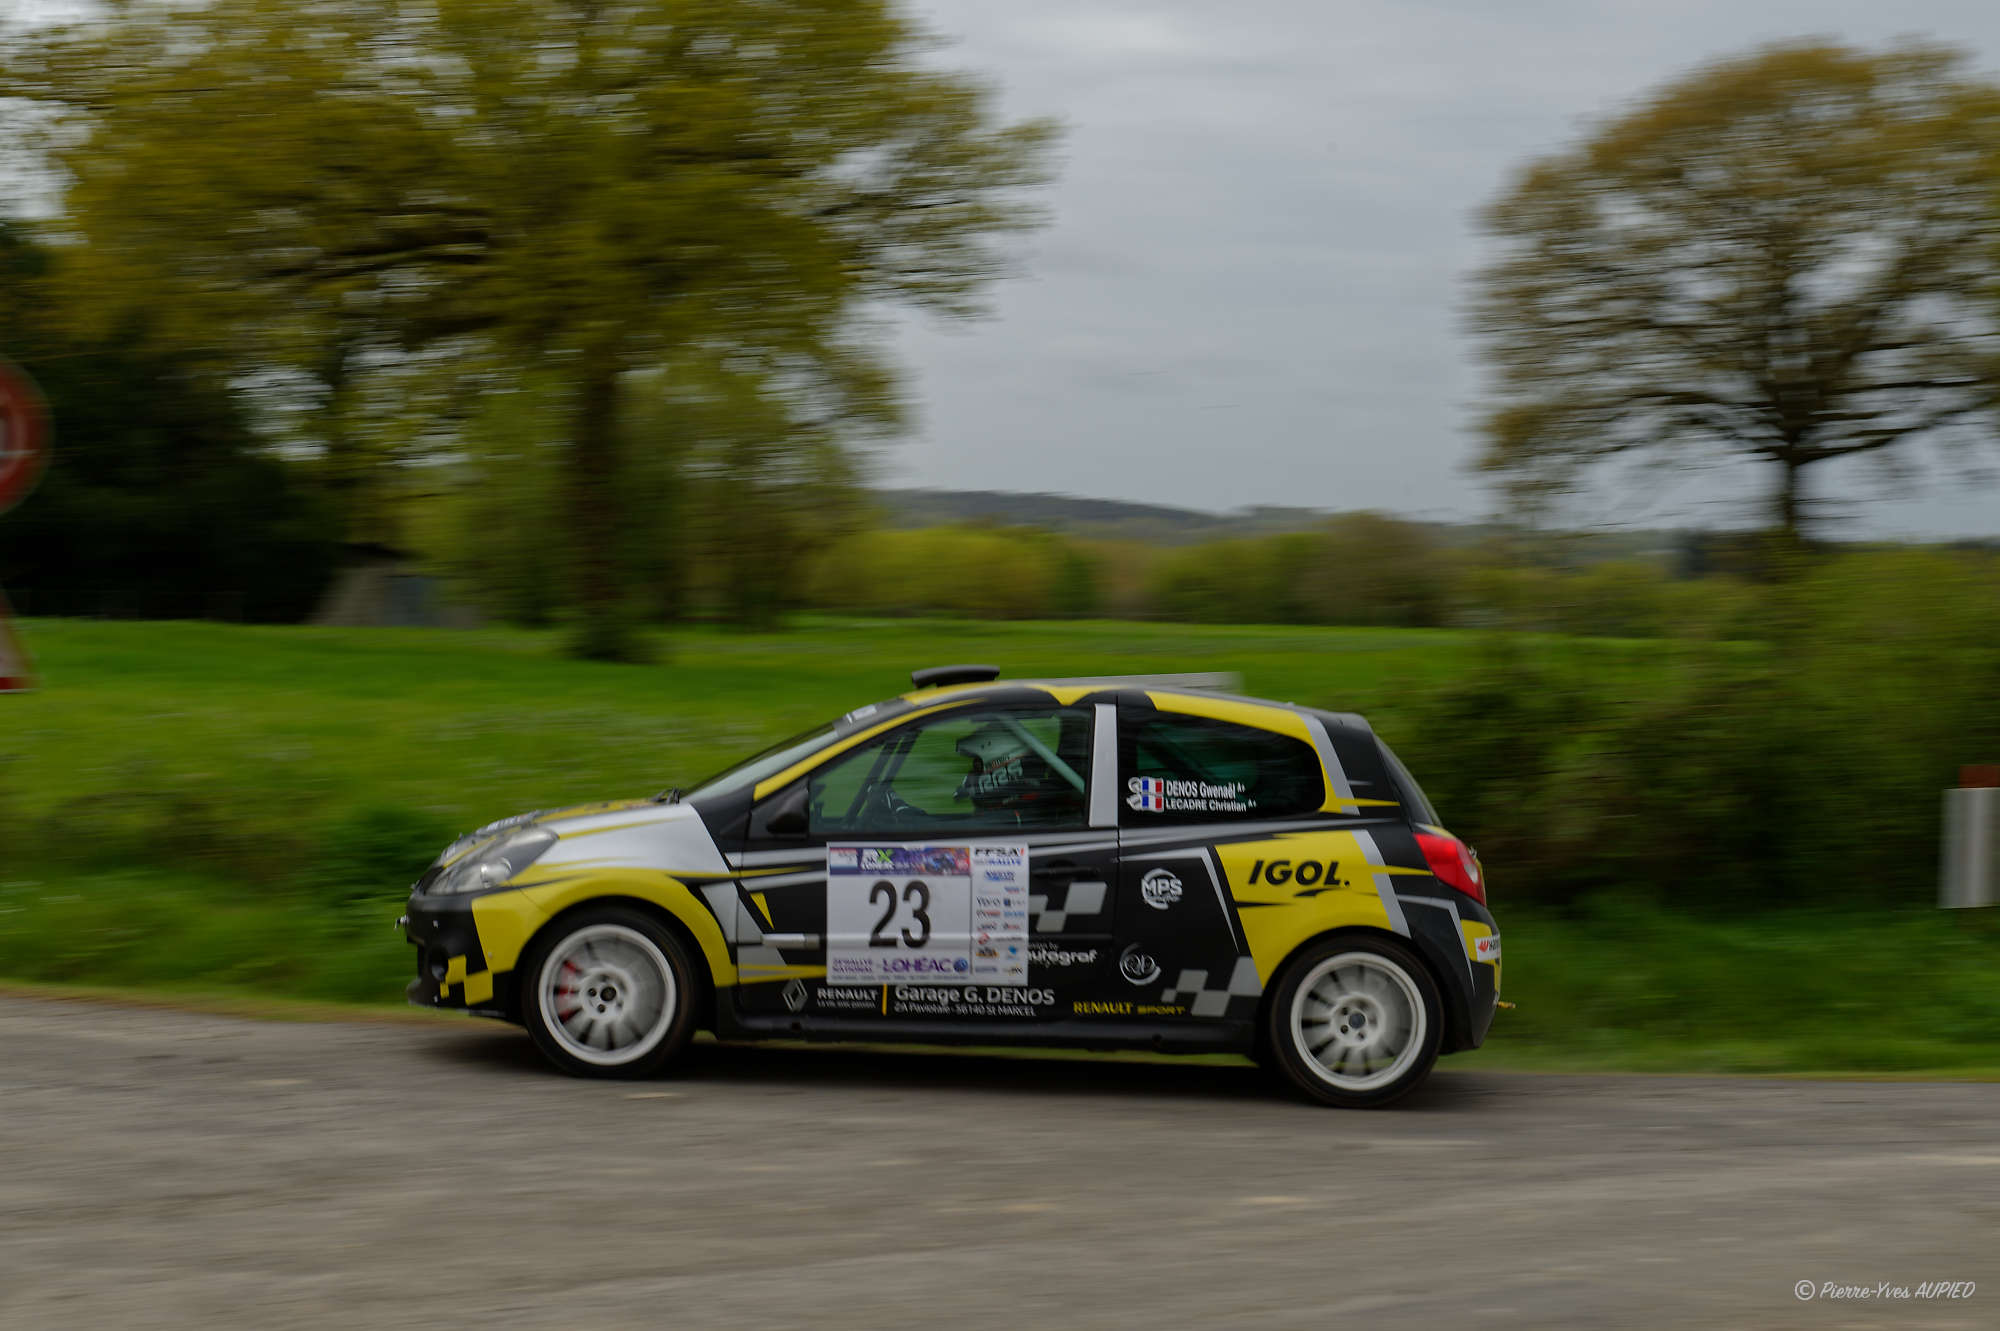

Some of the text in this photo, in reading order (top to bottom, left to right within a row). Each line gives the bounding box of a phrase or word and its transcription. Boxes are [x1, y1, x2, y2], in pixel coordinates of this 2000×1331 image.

[1166, 780, 1198, 797] DENOS
[1199, 781, 1236, 799] Gwenaël
[1165, 798, 1208, 811] LECADRE
[1208, 798, 1247, 812] Christian
[1141, 879, 1183, 896] MPS
[868, 879, 931, 949] 23
[816, 987, 878, 1001] RENAULT
[894, 985, 961, 1006] Garage
[963, 986, 984, 1004] G.
[985, 987, 1056, 1006] DENOS
[1073, 1001, 1186, 1015] RENAULT SPORT
